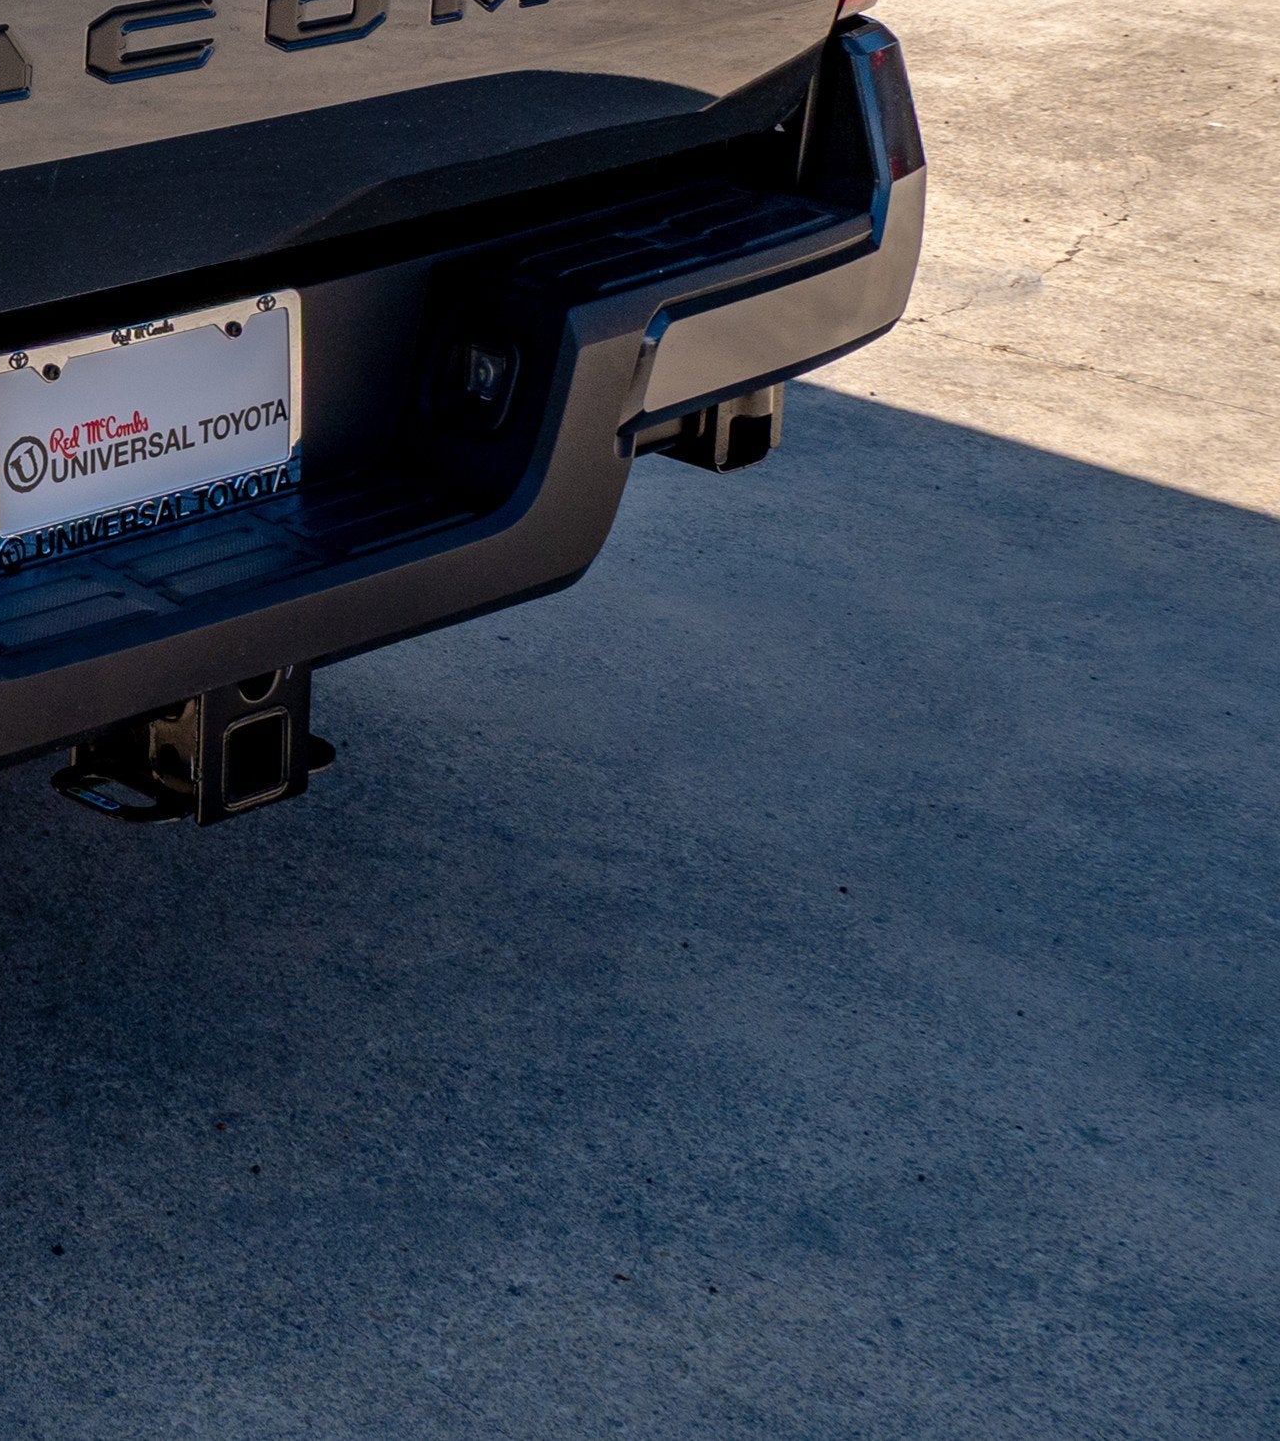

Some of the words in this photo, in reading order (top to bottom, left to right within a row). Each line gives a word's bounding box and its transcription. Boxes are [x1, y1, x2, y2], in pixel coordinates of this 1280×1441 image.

[49, 427, 80, 459] Red
[81, 411, 149, 445] McCombs
[51, 426, 195, 483] UNIVERSAL
[198, 398, 289, 446] TOYOTA
[35, 492, 190, 559] UNIVERSAL
[192, 463, 292, 518] TOYOTA
